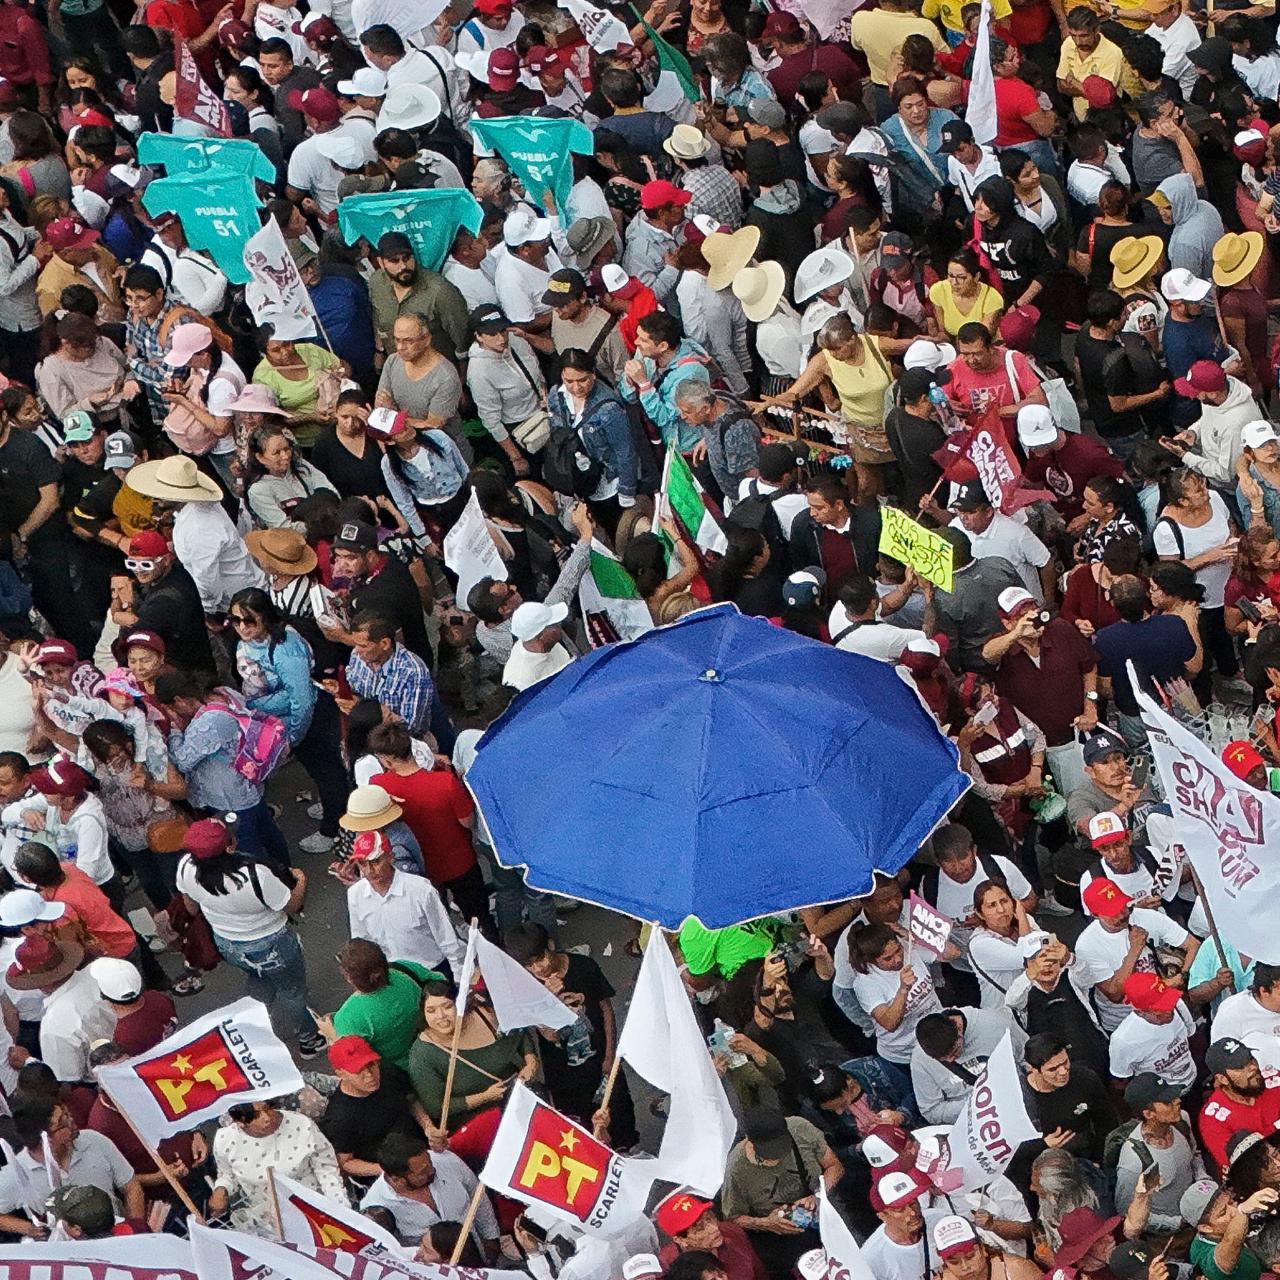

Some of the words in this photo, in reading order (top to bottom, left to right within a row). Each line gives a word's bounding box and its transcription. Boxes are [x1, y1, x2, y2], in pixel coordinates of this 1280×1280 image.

[527, 164, 554, 182] 51
[195, 206, 238, 217] PUEBLA
[213, 219, 241, 237] 51
[155, 1058, 228, 1115] PT
[519, 1139, 600, 1205] PT
